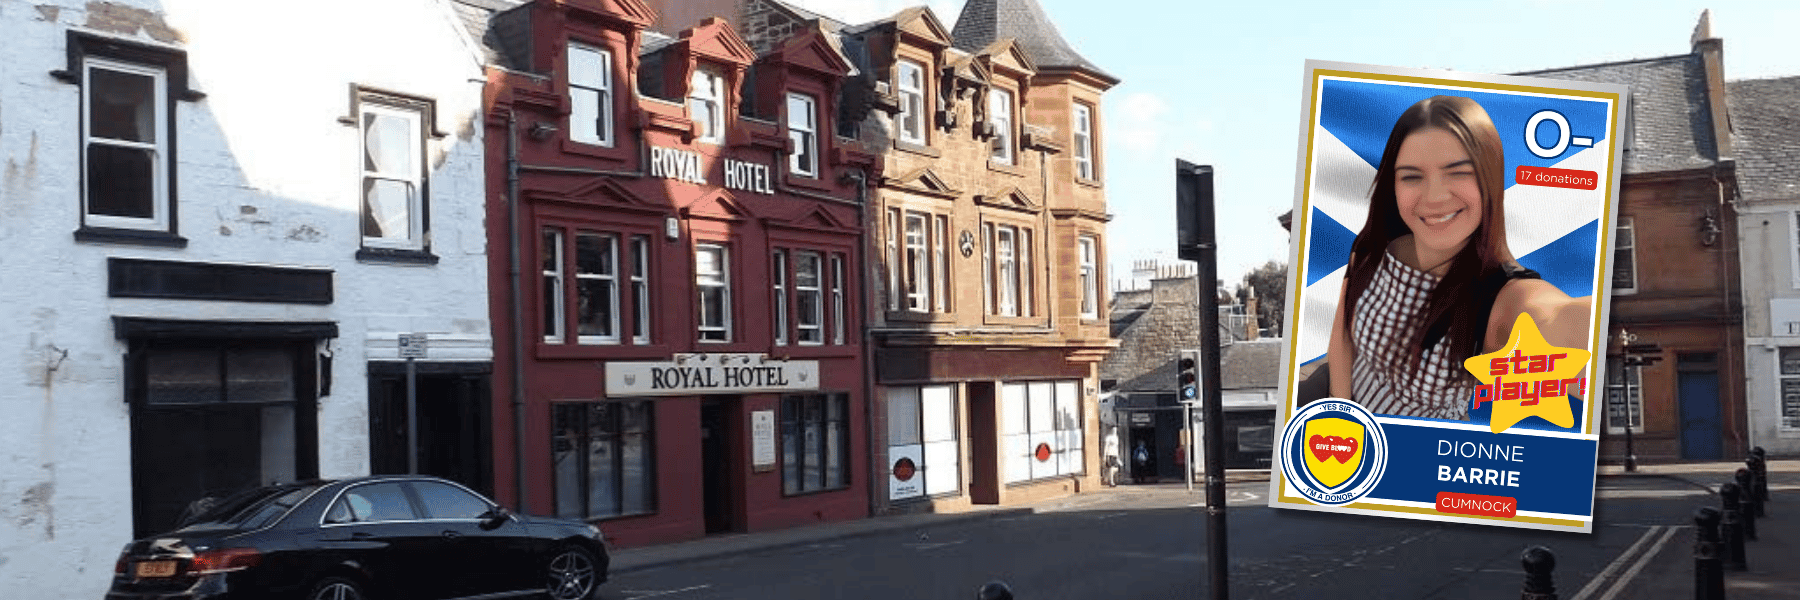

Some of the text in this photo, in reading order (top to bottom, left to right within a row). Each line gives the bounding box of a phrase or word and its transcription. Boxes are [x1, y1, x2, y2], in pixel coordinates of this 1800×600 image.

[651, 146, 774, 194] ROYAL HOTEL
[651, 366, 788, 389] ROYAL HOTEL
